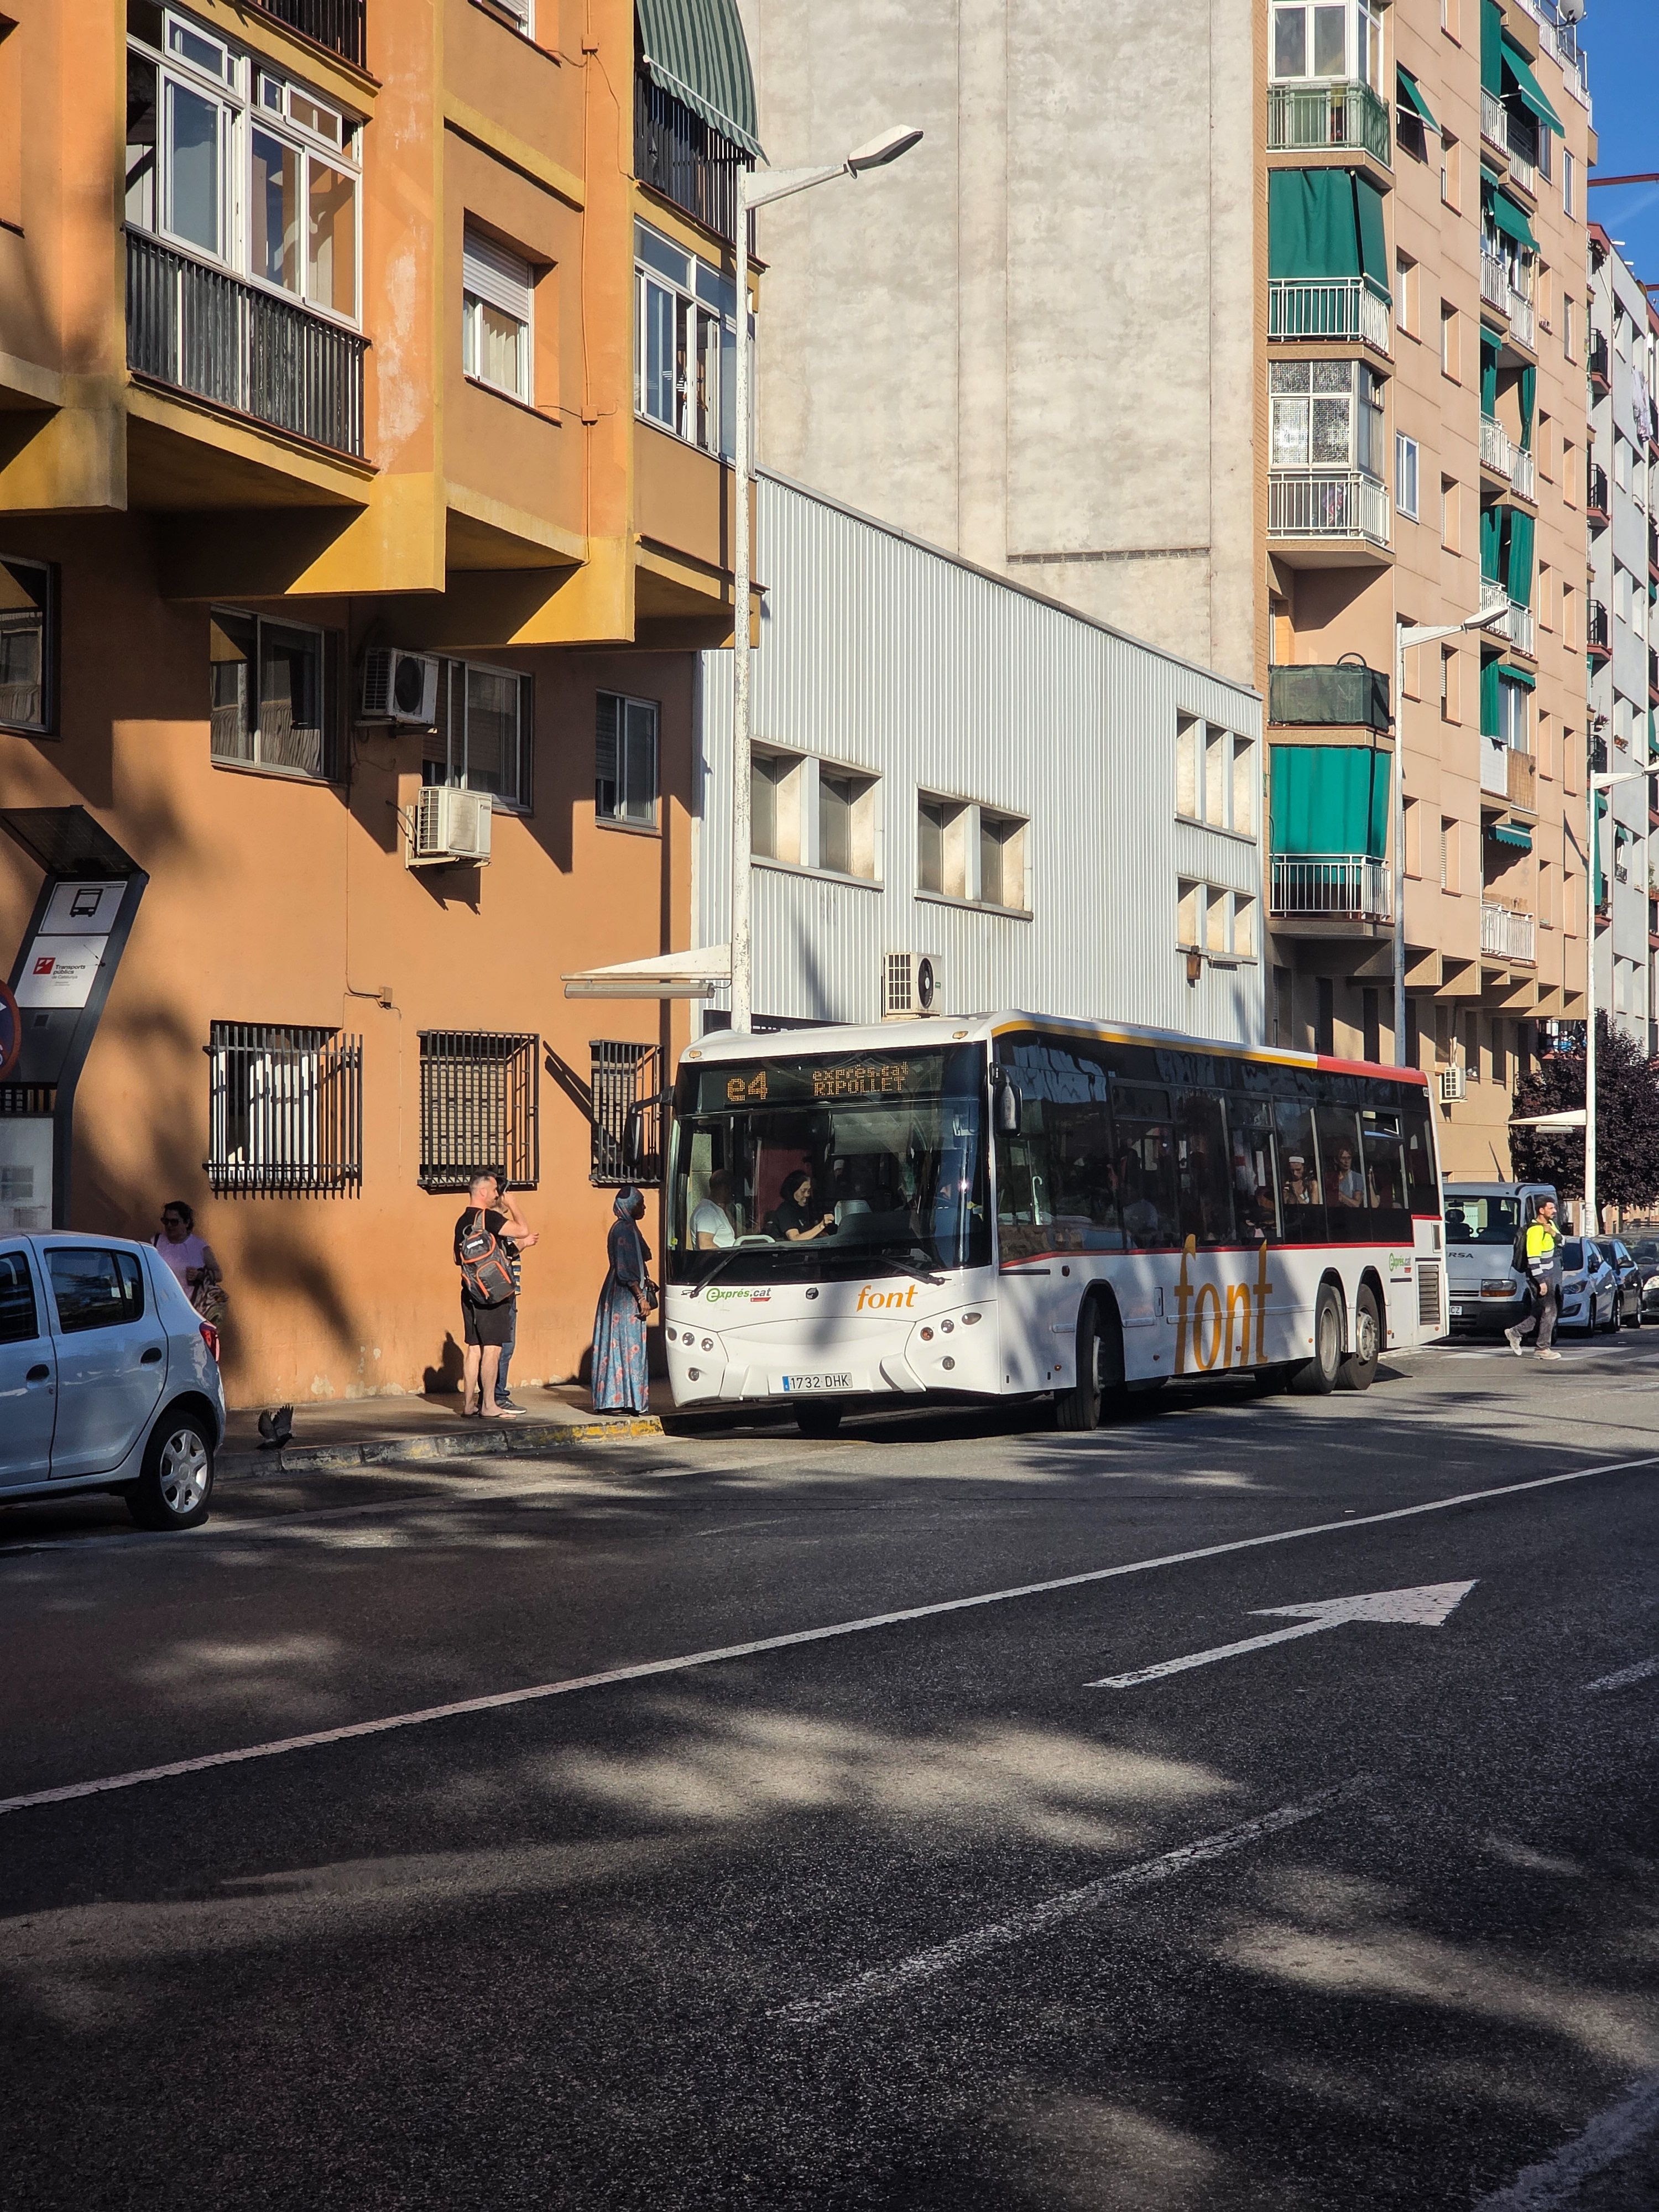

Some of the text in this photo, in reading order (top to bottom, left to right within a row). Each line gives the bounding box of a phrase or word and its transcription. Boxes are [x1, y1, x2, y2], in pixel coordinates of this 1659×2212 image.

[727, 1071, 768, 1102] e4
[814, 1076, 906, 1096] RIPOLLET
[706, 1287, 771, 1302] exprés.cat
[856, 1284, 919, 1312] font
[1173, 1233, 1272, 1375] font
[791, 1374, 849, 1389] 1732 DHK
